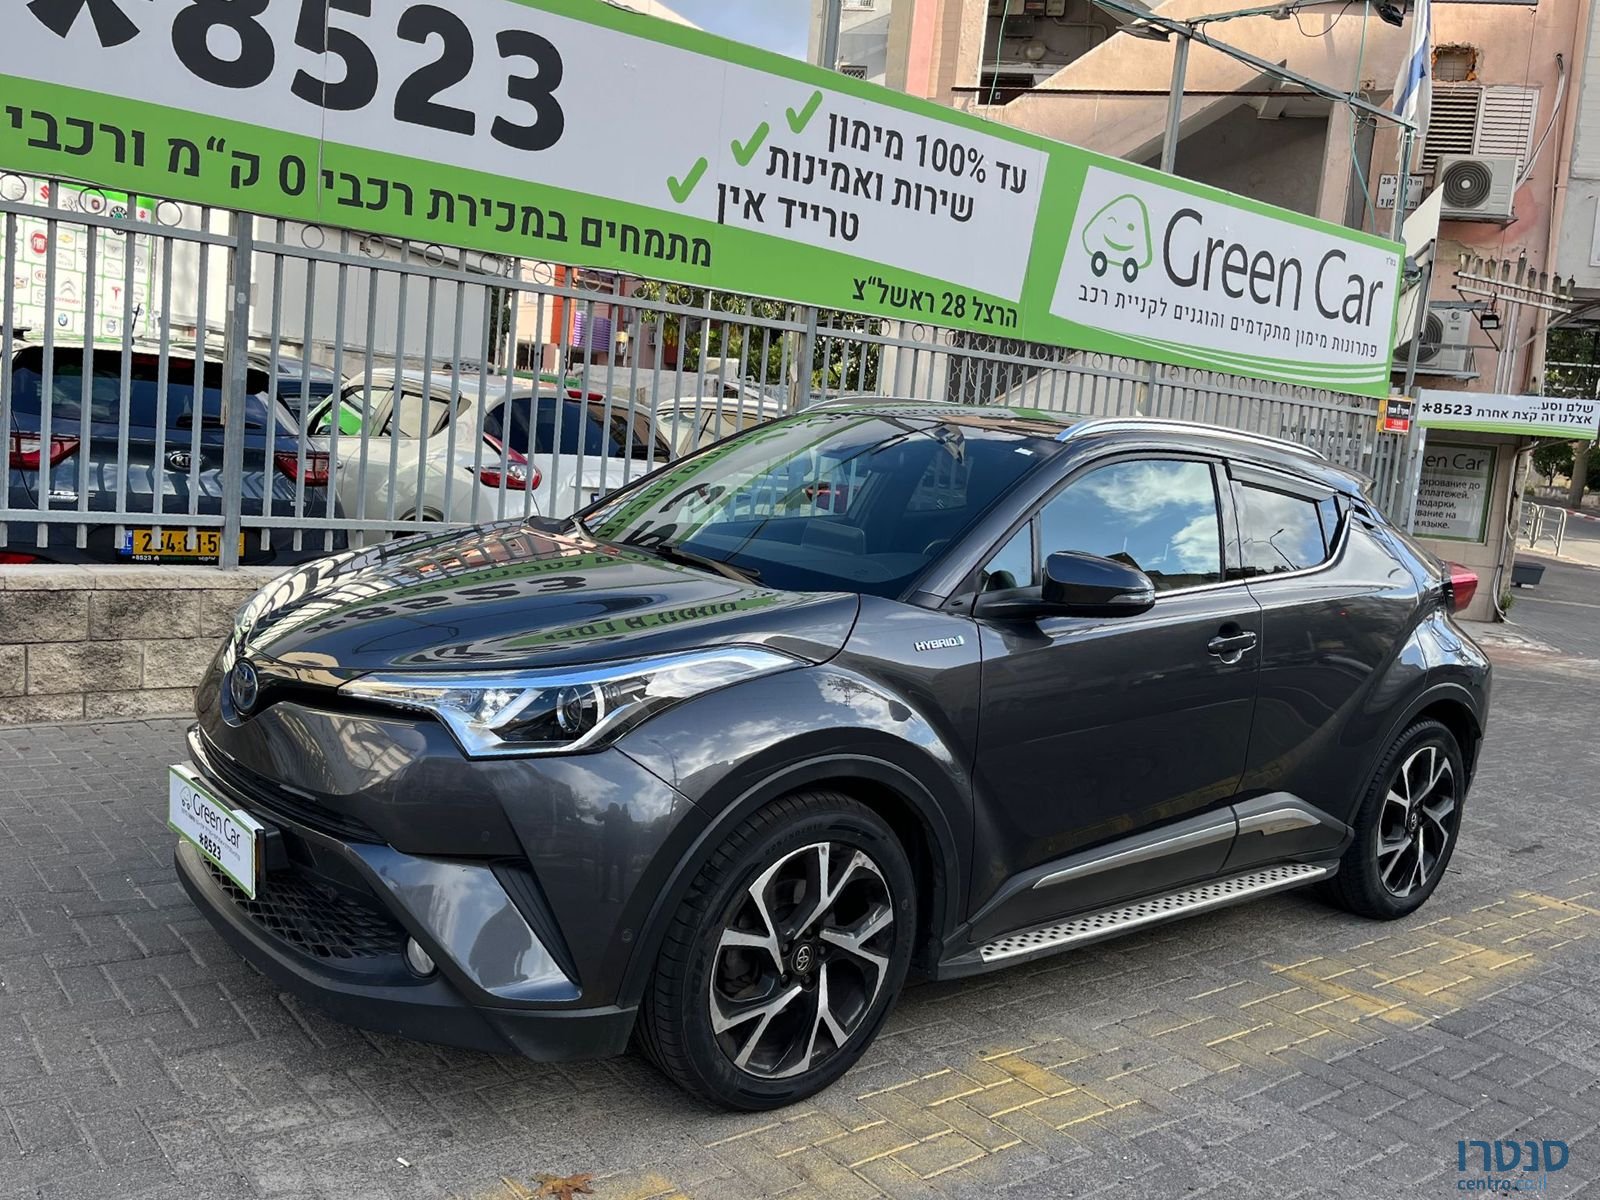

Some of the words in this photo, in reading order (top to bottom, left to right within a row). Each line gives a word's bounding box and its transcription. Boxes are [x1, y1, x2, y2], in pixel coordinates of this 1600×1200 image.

[6, 106, 145, 167] ורכבי
[829, 113, 904, 160] מימון
[766, 145, 883, 201] ואמינות
[916, 134, 987, 183] 100%
[279, 155, 305, 196] 0
[996, 160, 1027, 194] עד
[321, 169, 413, 216] רכבי
[717, 183, 767, 224] אין
[891, 177, 974, 222] שירות
[427, 188, 568, 243] במכירת
[777, 196, 859, 241] טרייד
[581, 216, 711, 267] מתמחים
[1163, 208, 1302, 311] Green
[1314, 249, 1384, 327] Car
[941, 291, 967, 318] 28
[1078, 285, 1108, 305] רכב
[1114, 292, 1168, 319] לקניית
[972, 296, 1018, 328] הרצל
[1174, 304, 1224, 328] והוגנים
[1231, 316, 1290, 342] מתקדמים
[1295, 328, 1327, 348] מימון
[1331, 337, 1377, 358] פתרונות
[1476, 409, 1509, 419] אחרת
[1512, 410, 1537, 422] קצת
[1541, 413, 1555, 422] זה
[1559, 413, 1593, 424] אצלנו
[1567, 402, 1594, 413] שלם
[1453, 454, 1484, 470] Car
[1468, 482, 1480, 490] до
[914, 637, 957, 652] HYBRID
[193, 793, 222, 834] Green
[224, 818, 240, 848] Car
